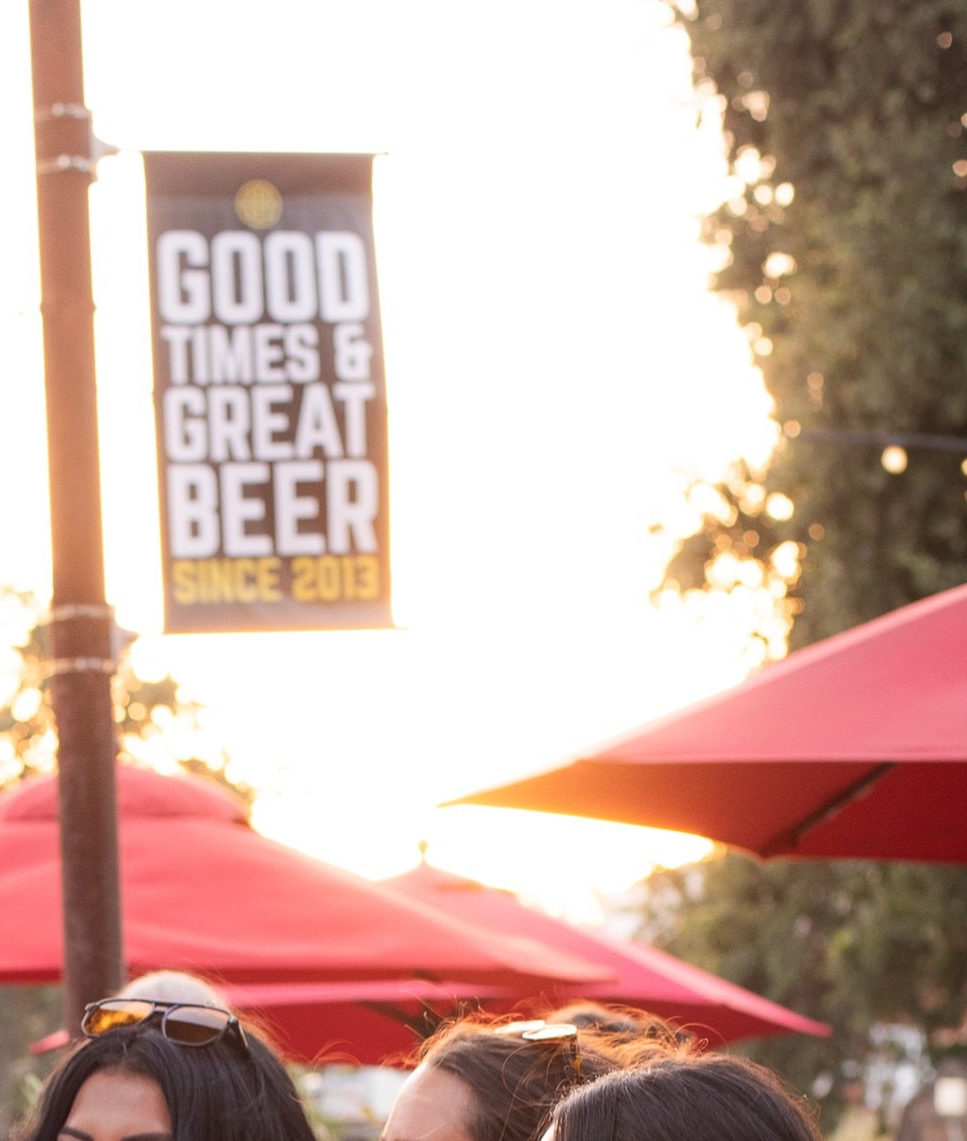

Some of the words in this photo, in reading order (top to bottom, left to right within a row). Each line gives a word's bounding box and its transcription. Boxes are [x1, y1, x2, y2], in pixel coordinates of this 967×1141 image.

[156, 230, 369, 325] GOOD
[160, 322, 321, 386] TIMES
[334, 323, 374, 382] &
[163, 382, 376, 463] GREAT
[168, 459, 379, 558] BEER
[173, 557, 282, 605] SINCE
[290, 555, 380, 602] 2013
